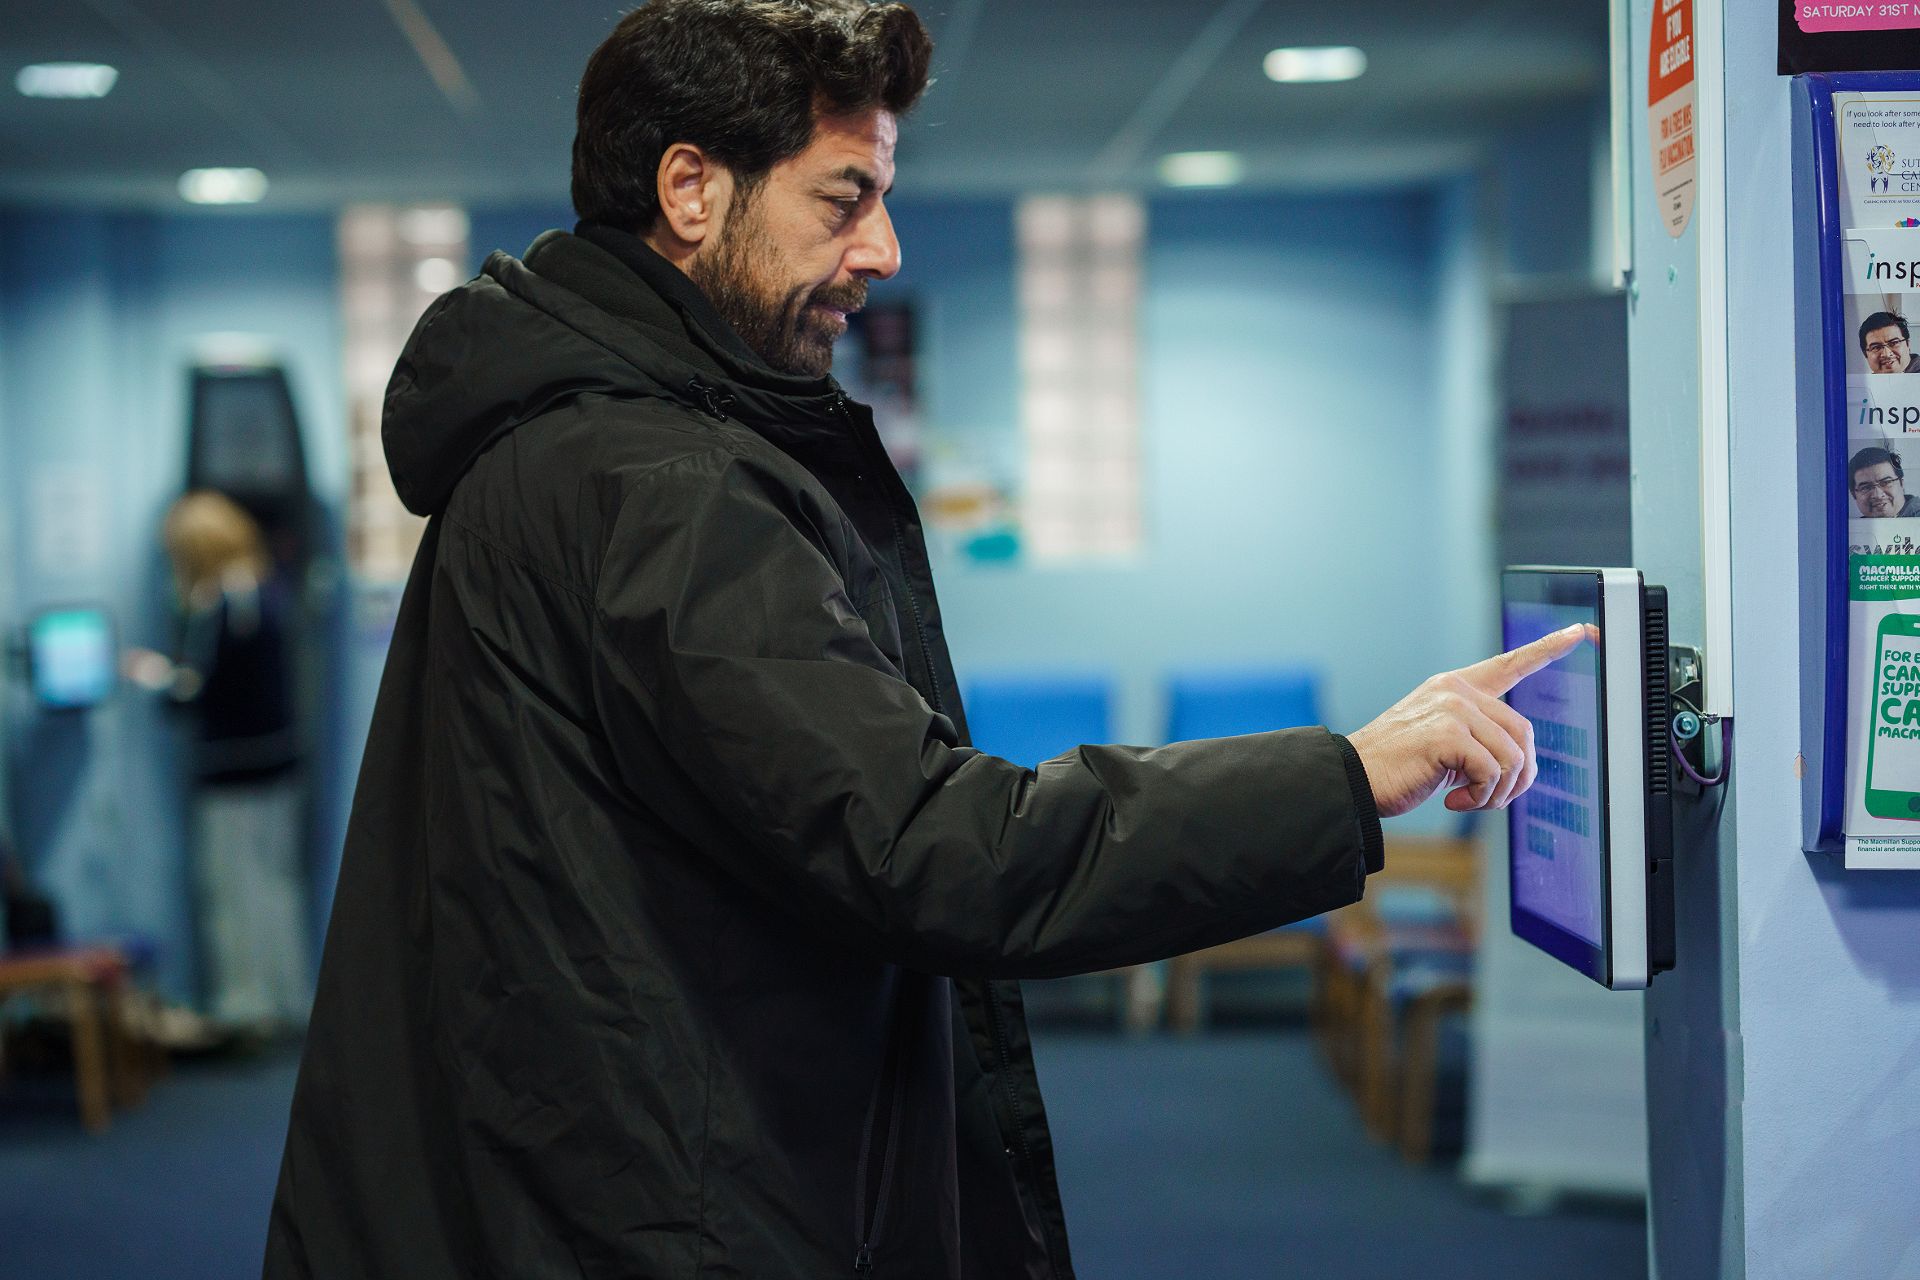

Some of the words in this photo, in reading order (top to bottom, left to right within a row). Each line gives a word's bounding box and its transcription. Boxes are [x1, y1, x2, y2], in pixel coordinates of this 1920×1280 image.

[1803, 5, 1874, 18] SATURDAY
[1879, 4, 1909, 16] 31ST
[1854, 120, 1871, 128] need
[1860, 399, 1920, 432] insp
[1885, 650, 1911, 662] FOR
